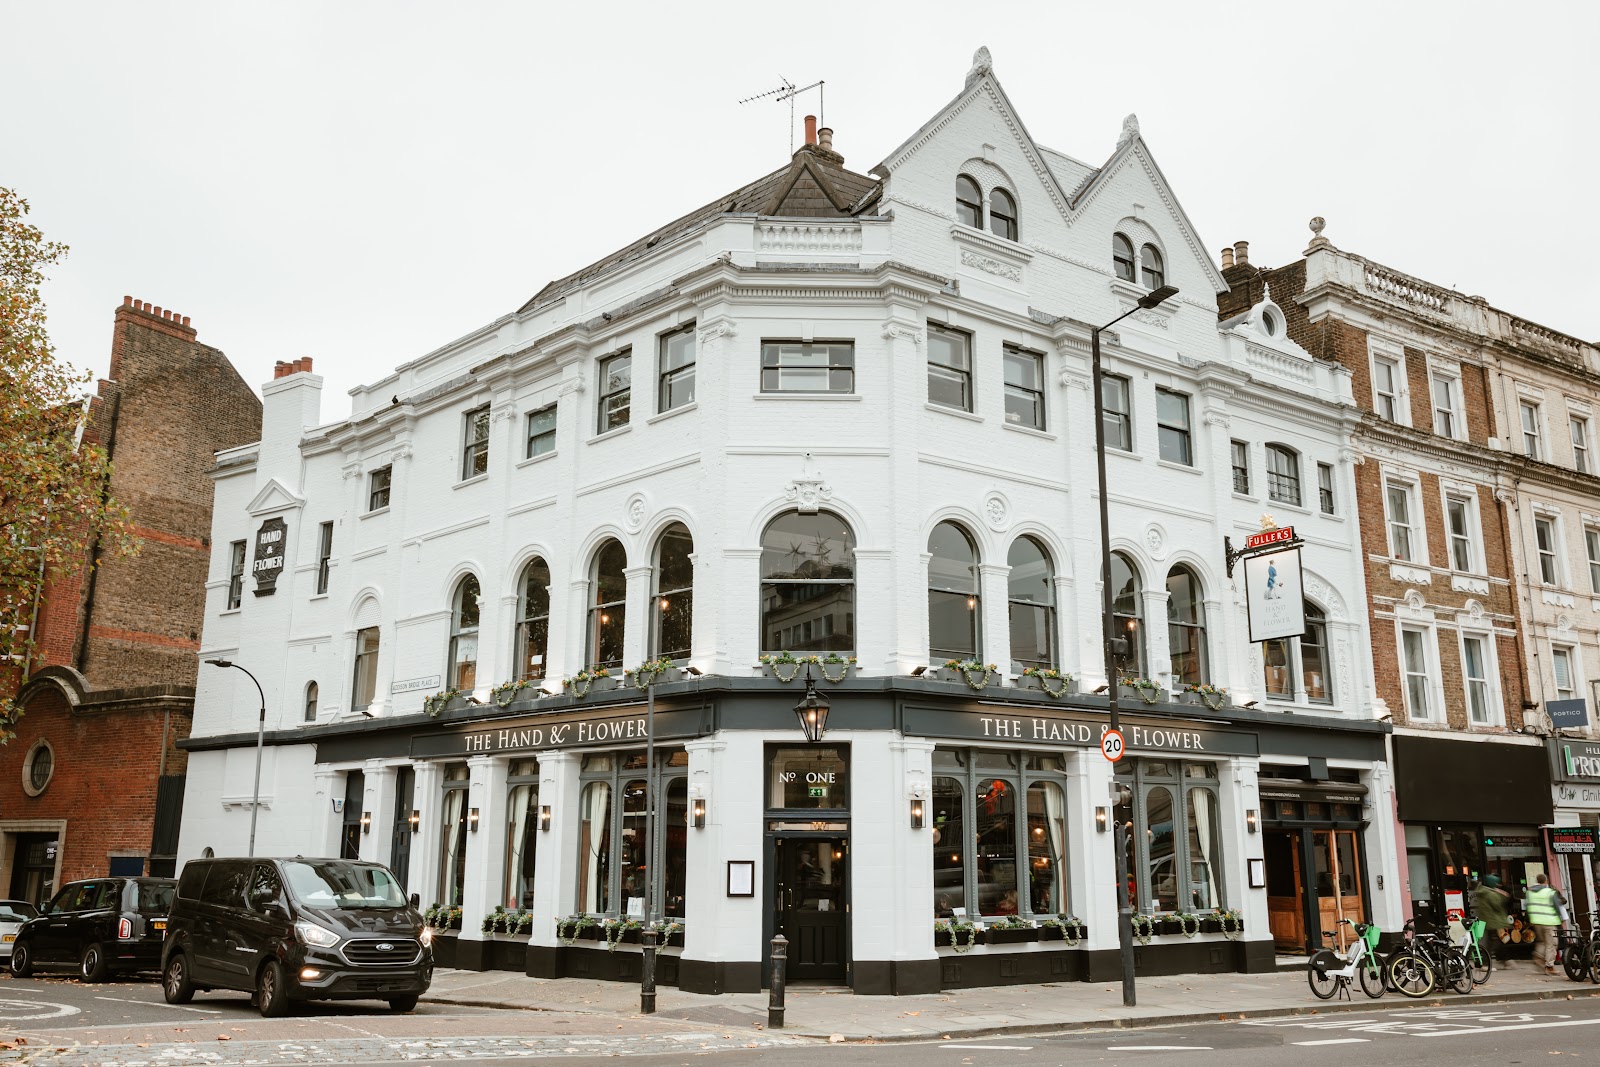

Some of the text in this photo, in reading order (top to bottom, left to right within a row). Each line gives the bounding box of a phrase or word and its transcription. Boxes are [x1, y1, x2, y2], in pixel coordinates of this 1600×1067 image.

[260, 530, 282, 544] HAND
[1248, 530, 1289, 547] FULLER'S
[266, 546, 273, 554] &
[254, 556, 283, 572] FLOWER
[1266, 604, 1286, 613] HAND
[1264, 616, 1291, 626] FLOWER
[465, 719, 649, 751] THE HAND & FLOWER
[980, 718, 1022, 738] THE
[1032, 718, 1091, 742] HAND
[1132, 726, 1204, 750] FLOWER
[1106, 738, 1121, 752] 20
[806, 772, 836, 784] ONE
